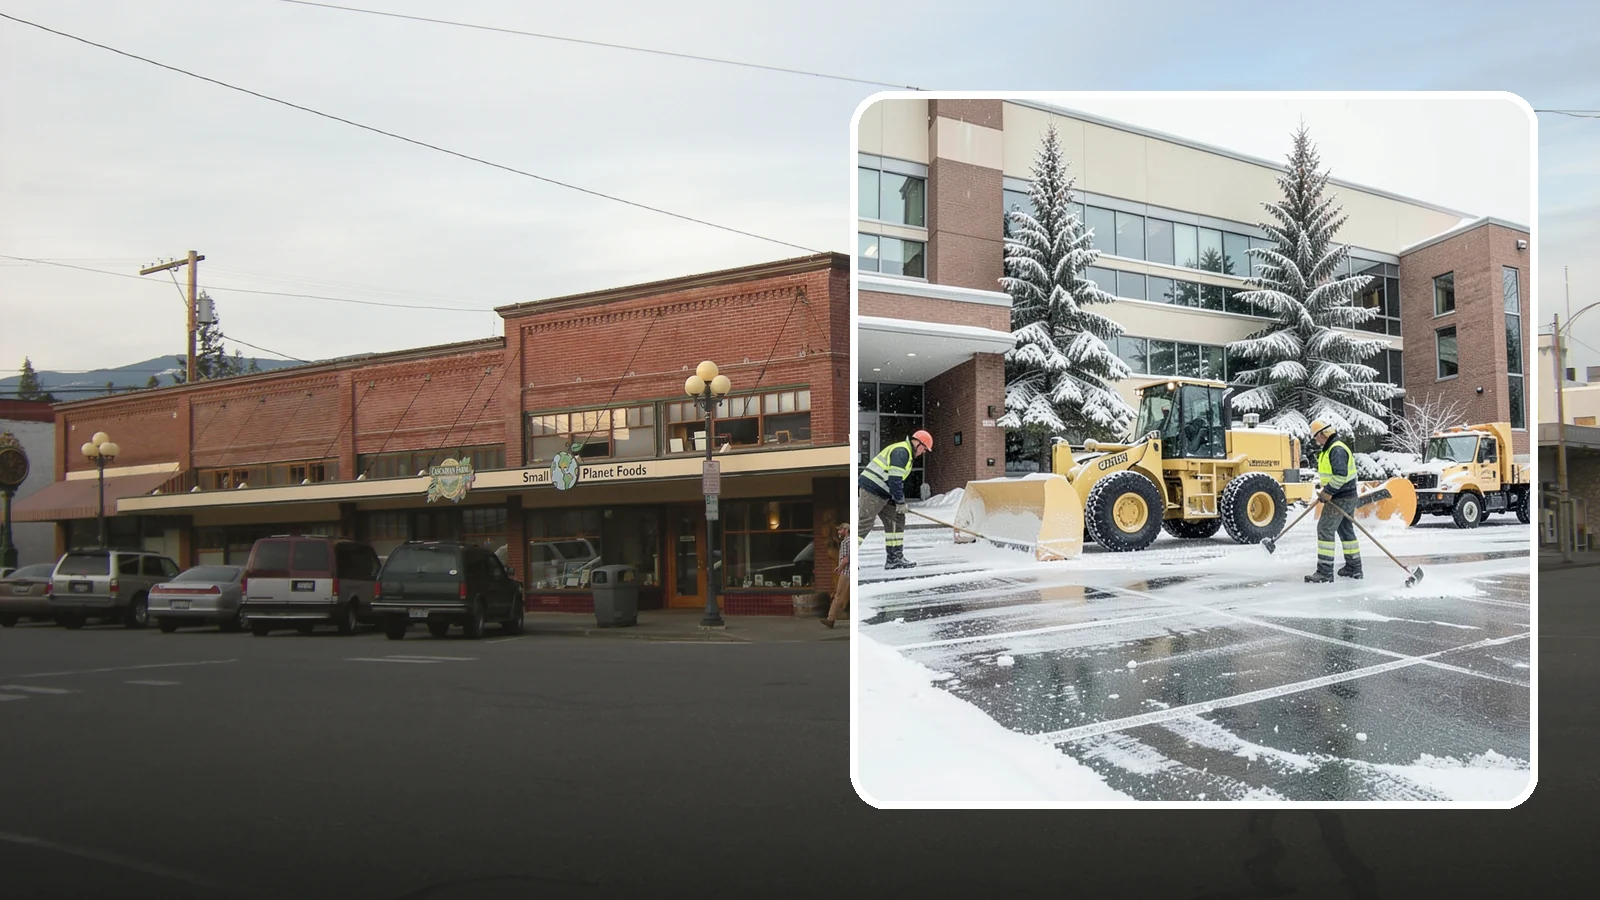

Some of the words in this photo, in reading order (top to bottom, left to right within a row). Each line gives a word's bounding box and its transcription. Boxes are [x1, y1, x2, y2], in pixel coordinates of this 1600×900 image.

[523, 471, 549, 483] Small
[583, 467, 614, 479] Planet
[616, 464, 647, 477] Foods
